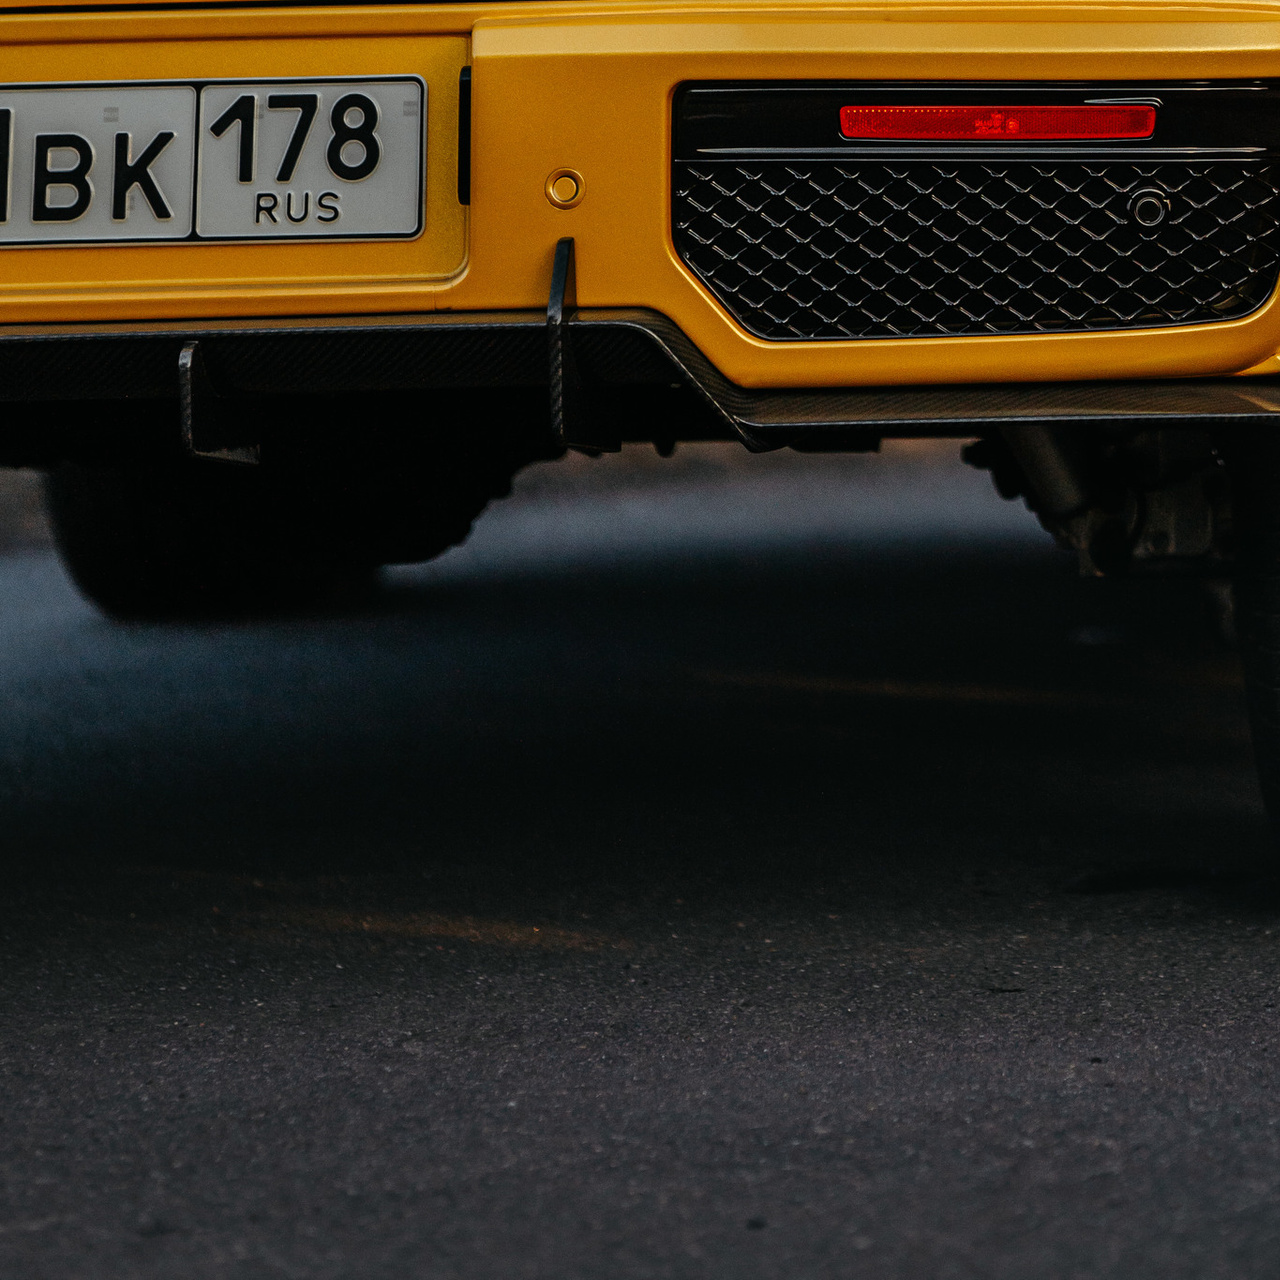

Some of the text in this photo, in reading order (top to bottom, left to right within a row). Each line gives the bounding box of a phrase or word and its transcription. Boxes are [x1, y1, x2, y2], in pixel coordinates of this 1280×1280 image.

[0, 93, 381, 223] BK 178
[255, 192, 341, 224] RUS
